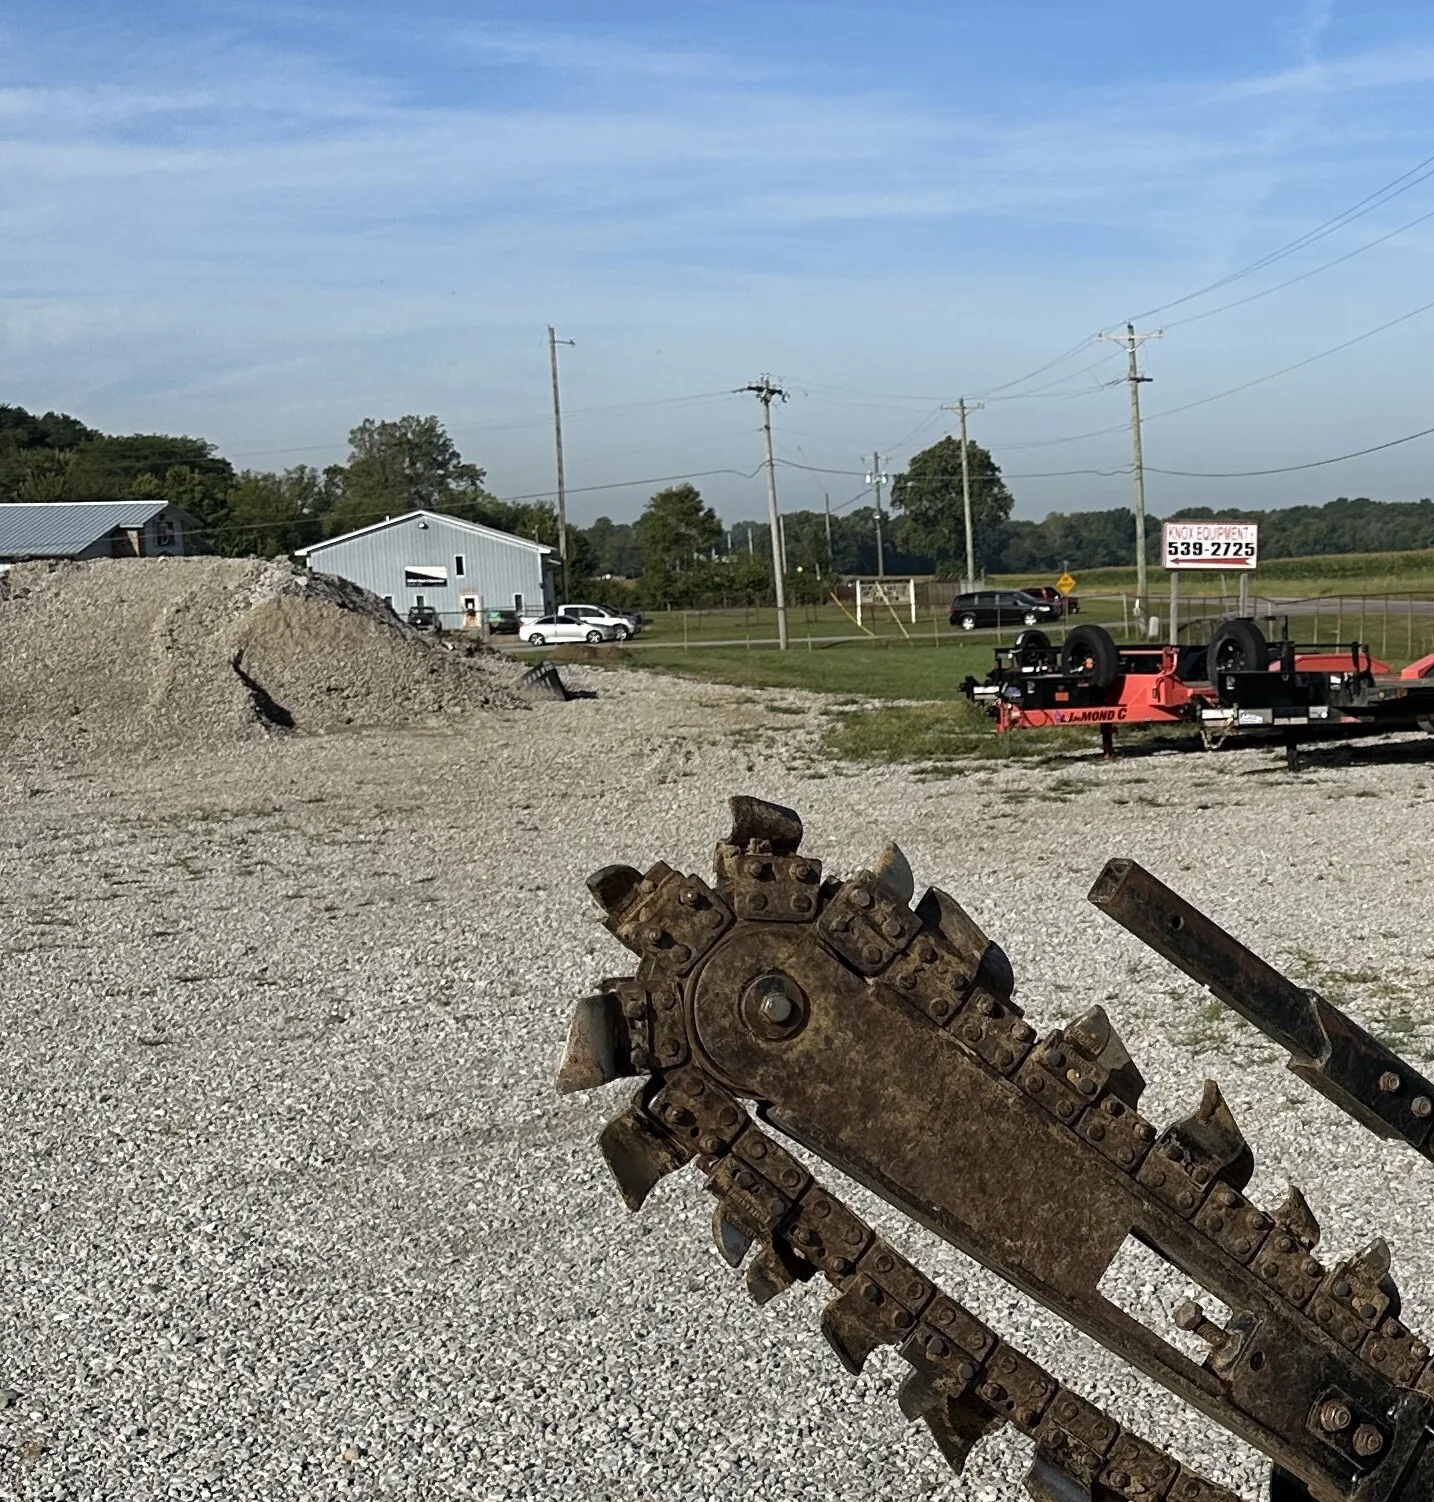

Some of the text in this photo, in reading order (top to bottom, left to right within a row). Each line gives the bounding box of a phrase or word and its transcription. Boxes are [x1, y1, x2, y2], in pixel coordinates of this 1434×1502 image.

[1168, 526, 1194, 540] KNOX
[1196, 526, 1249, 541] EQUIPMENT
[1168, 542, 1255, 556] 539-2725
